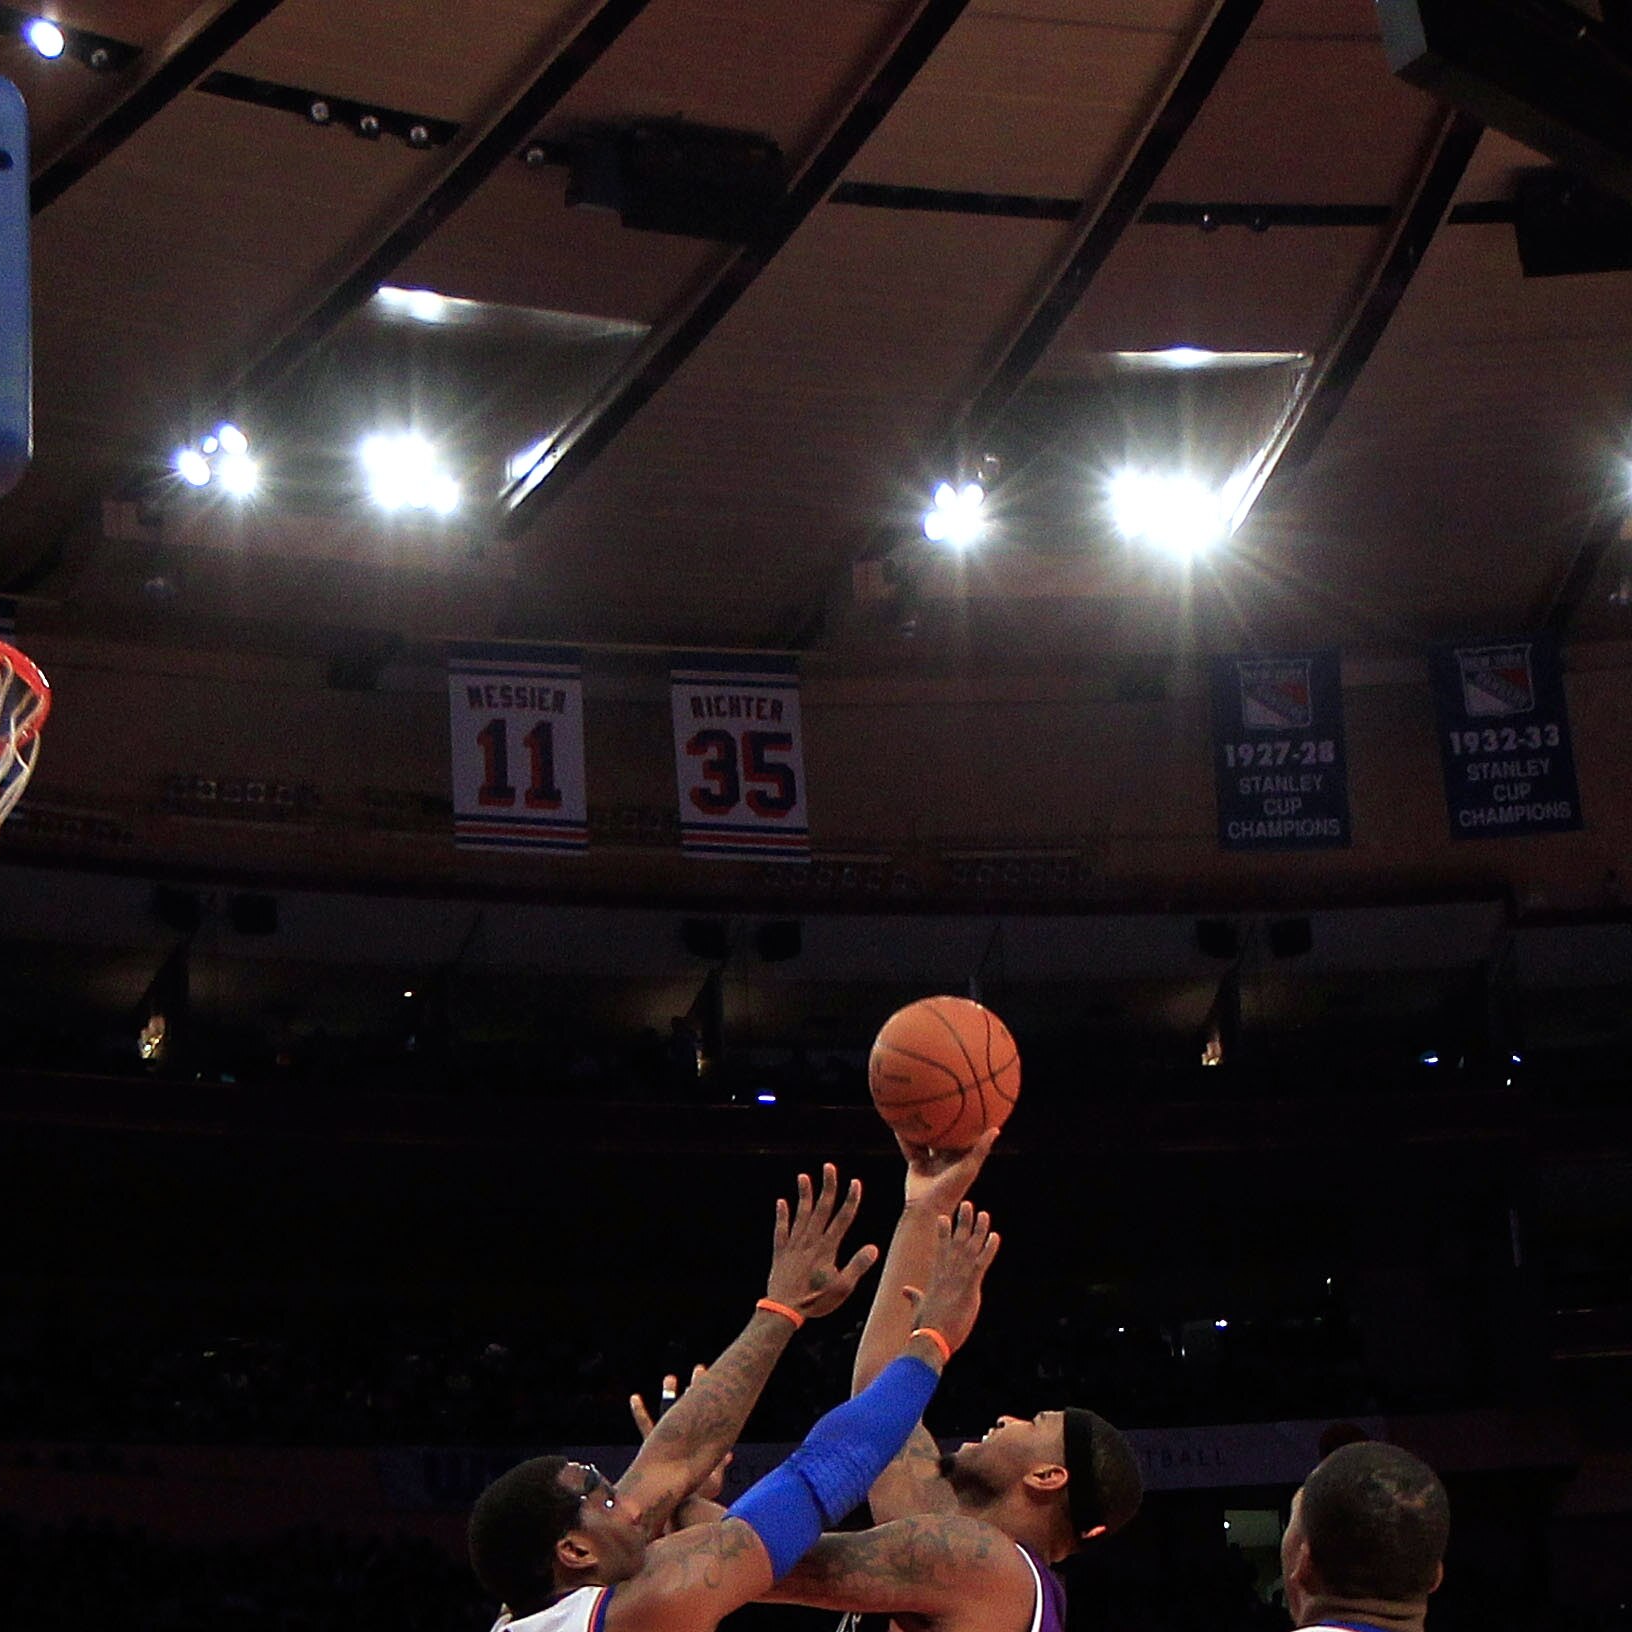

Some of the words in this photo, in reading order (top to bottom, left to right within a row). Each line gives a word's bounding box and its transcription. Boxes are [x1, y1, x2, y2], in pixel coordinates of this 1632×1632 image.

[466, 684, 566, 714] MESSIER
[691, 694, 783, 722] RICHTER
[1449, 724, 1560, 755] 1932-33
[476, 718, 564, 810] 11
[1225, 740, 1337, 768] 1927-28
[685, 729, 798, 820] 35
[1238, 773, 1323, 793] STANLEY
[1466, 757, 1550, 782] STANLEY
[1492, 782, 1531, 803] CUP
[1262, 798, 1303, 816] CUP
[1458, 800, 1572, 828] CHAMPIONS
[1227, 817, 1341, 839] CHAMPIONS
